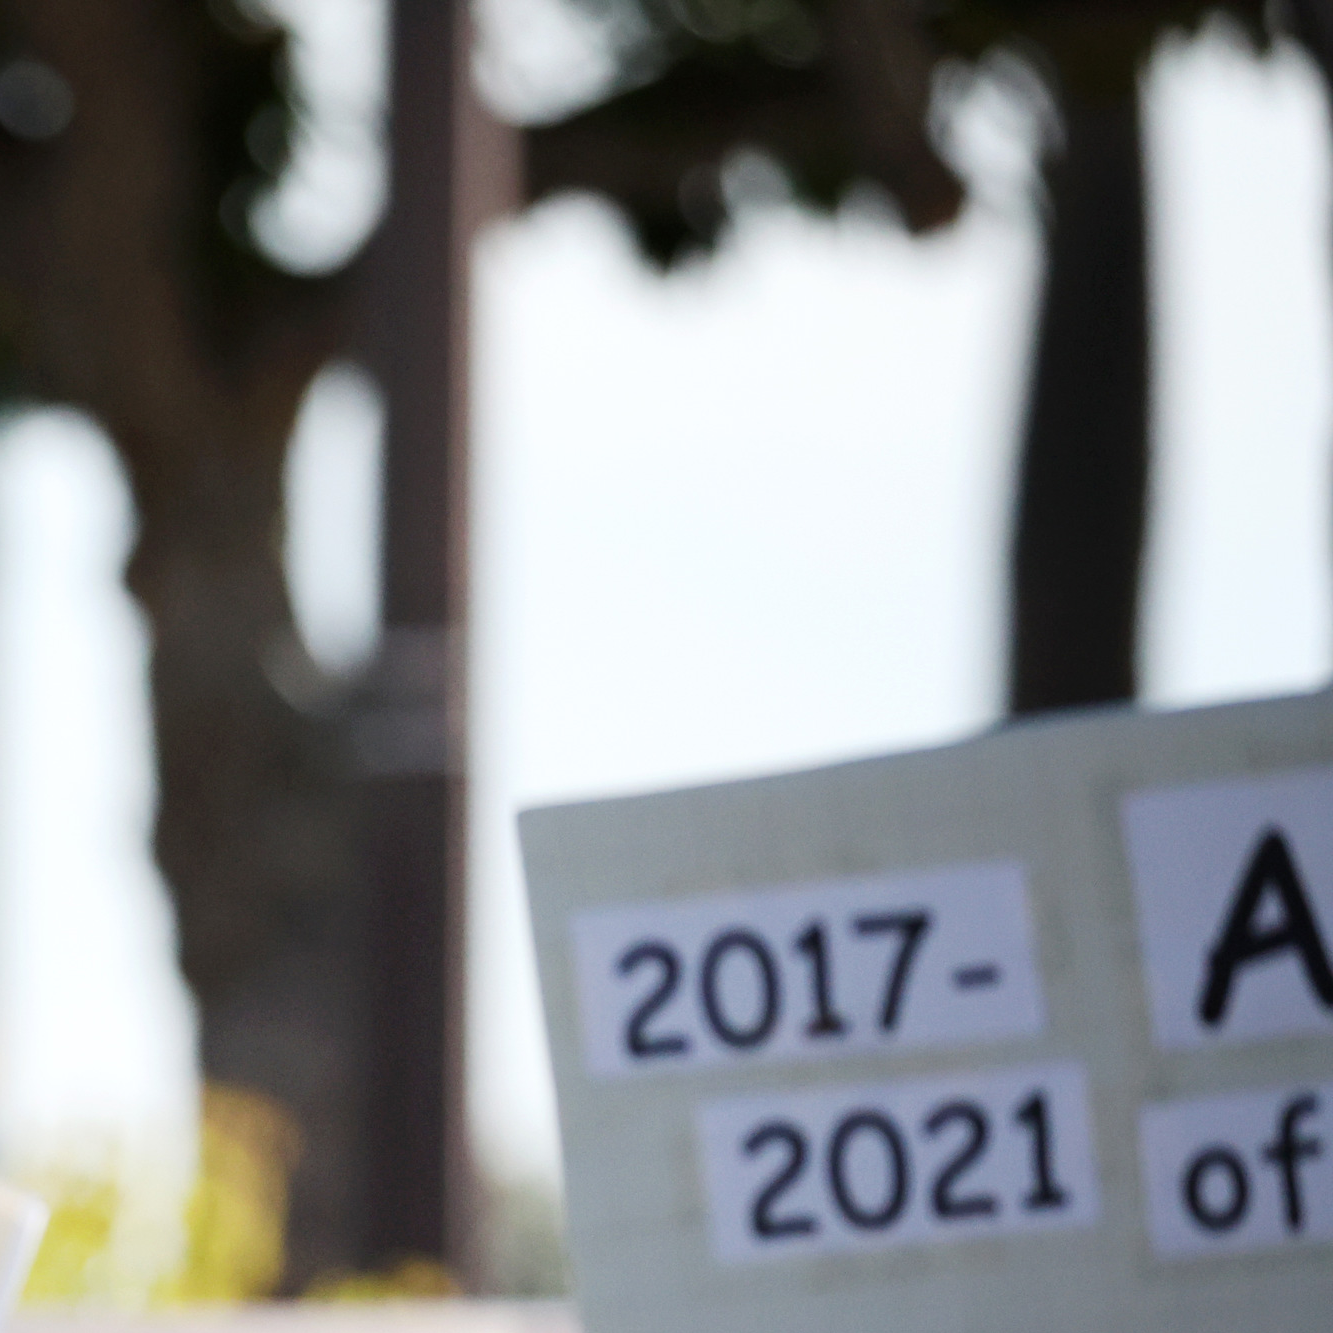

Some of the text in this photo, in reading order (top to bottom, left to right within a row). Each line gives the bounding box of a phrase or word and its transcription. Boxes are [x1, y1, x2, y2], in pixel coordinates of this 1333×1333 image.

[614, 908, 1001, 1062] 2017-
[741, 1089, 1071, 1241] 2021
[1179, 1090, 1325, 1237] of
